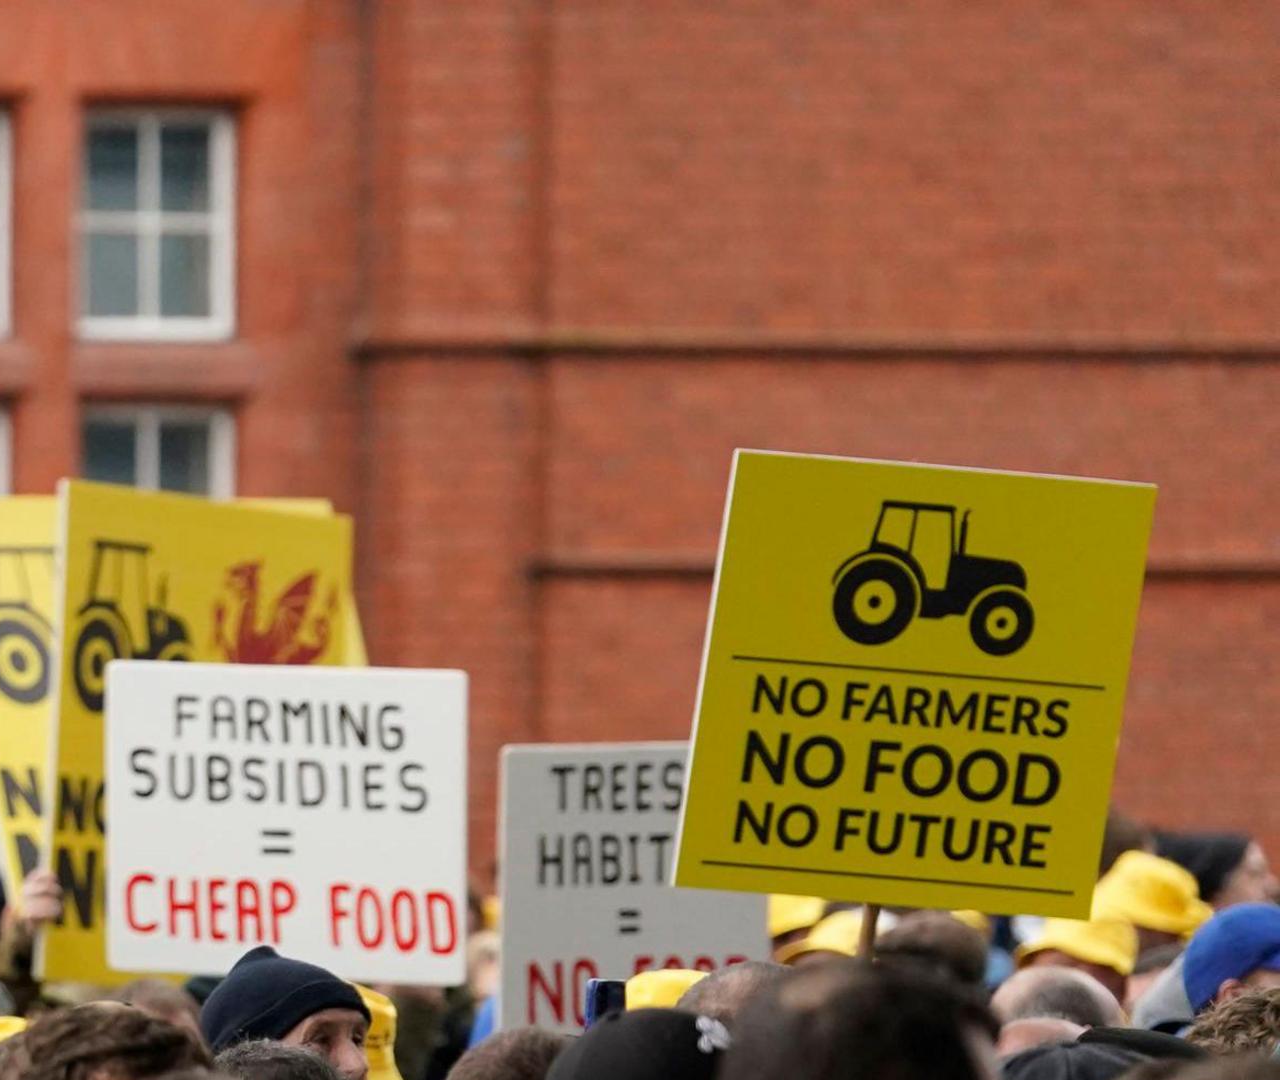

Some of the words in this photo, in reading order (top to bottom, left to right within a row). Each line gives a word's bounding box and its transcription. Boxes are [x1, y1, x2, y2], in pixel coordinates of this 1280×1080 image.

[176, 695, 404, 751] FARMING
[751, 674, 828, 718] NO
[841, 681, 1070, 739] FARMERS
[130, 748, 429, 813] SUBSIDIES
[551, 761, 683, 812] TREES
[741, 730, 845, 789] NO
[864, 740, 1062, 807] FOOD
[733, 799, 819, 848] NO
[833, 808, 1052, 869] FUTURE
[125, 873, 297, 945] CHEAP
[329, 884, 459, 957] FOOD
